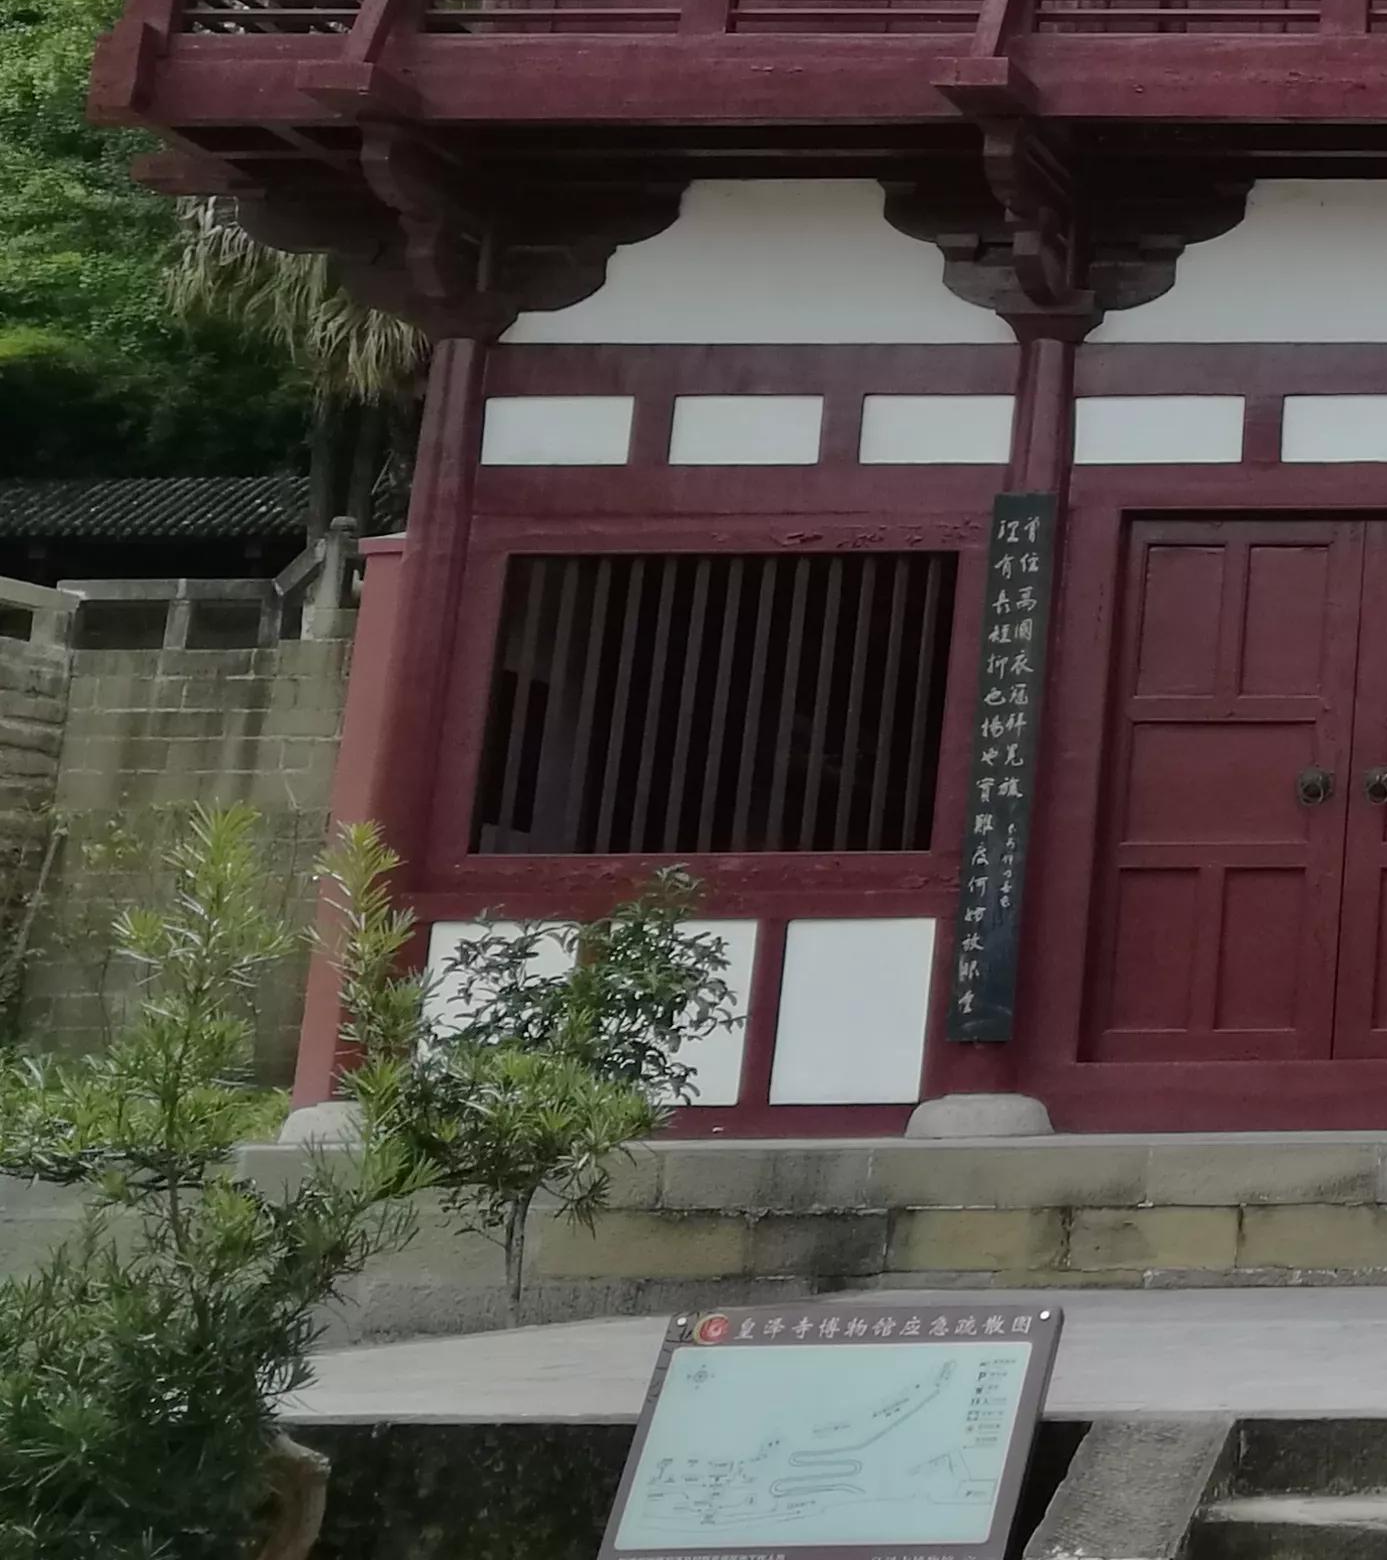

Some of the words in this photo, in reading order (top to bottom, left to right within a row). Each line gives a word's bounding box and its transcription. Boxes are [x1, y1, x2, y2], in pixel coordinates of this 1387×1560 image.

[734, 1315, 1033, 1341] 皇泽寺博物馆应急疏散图
